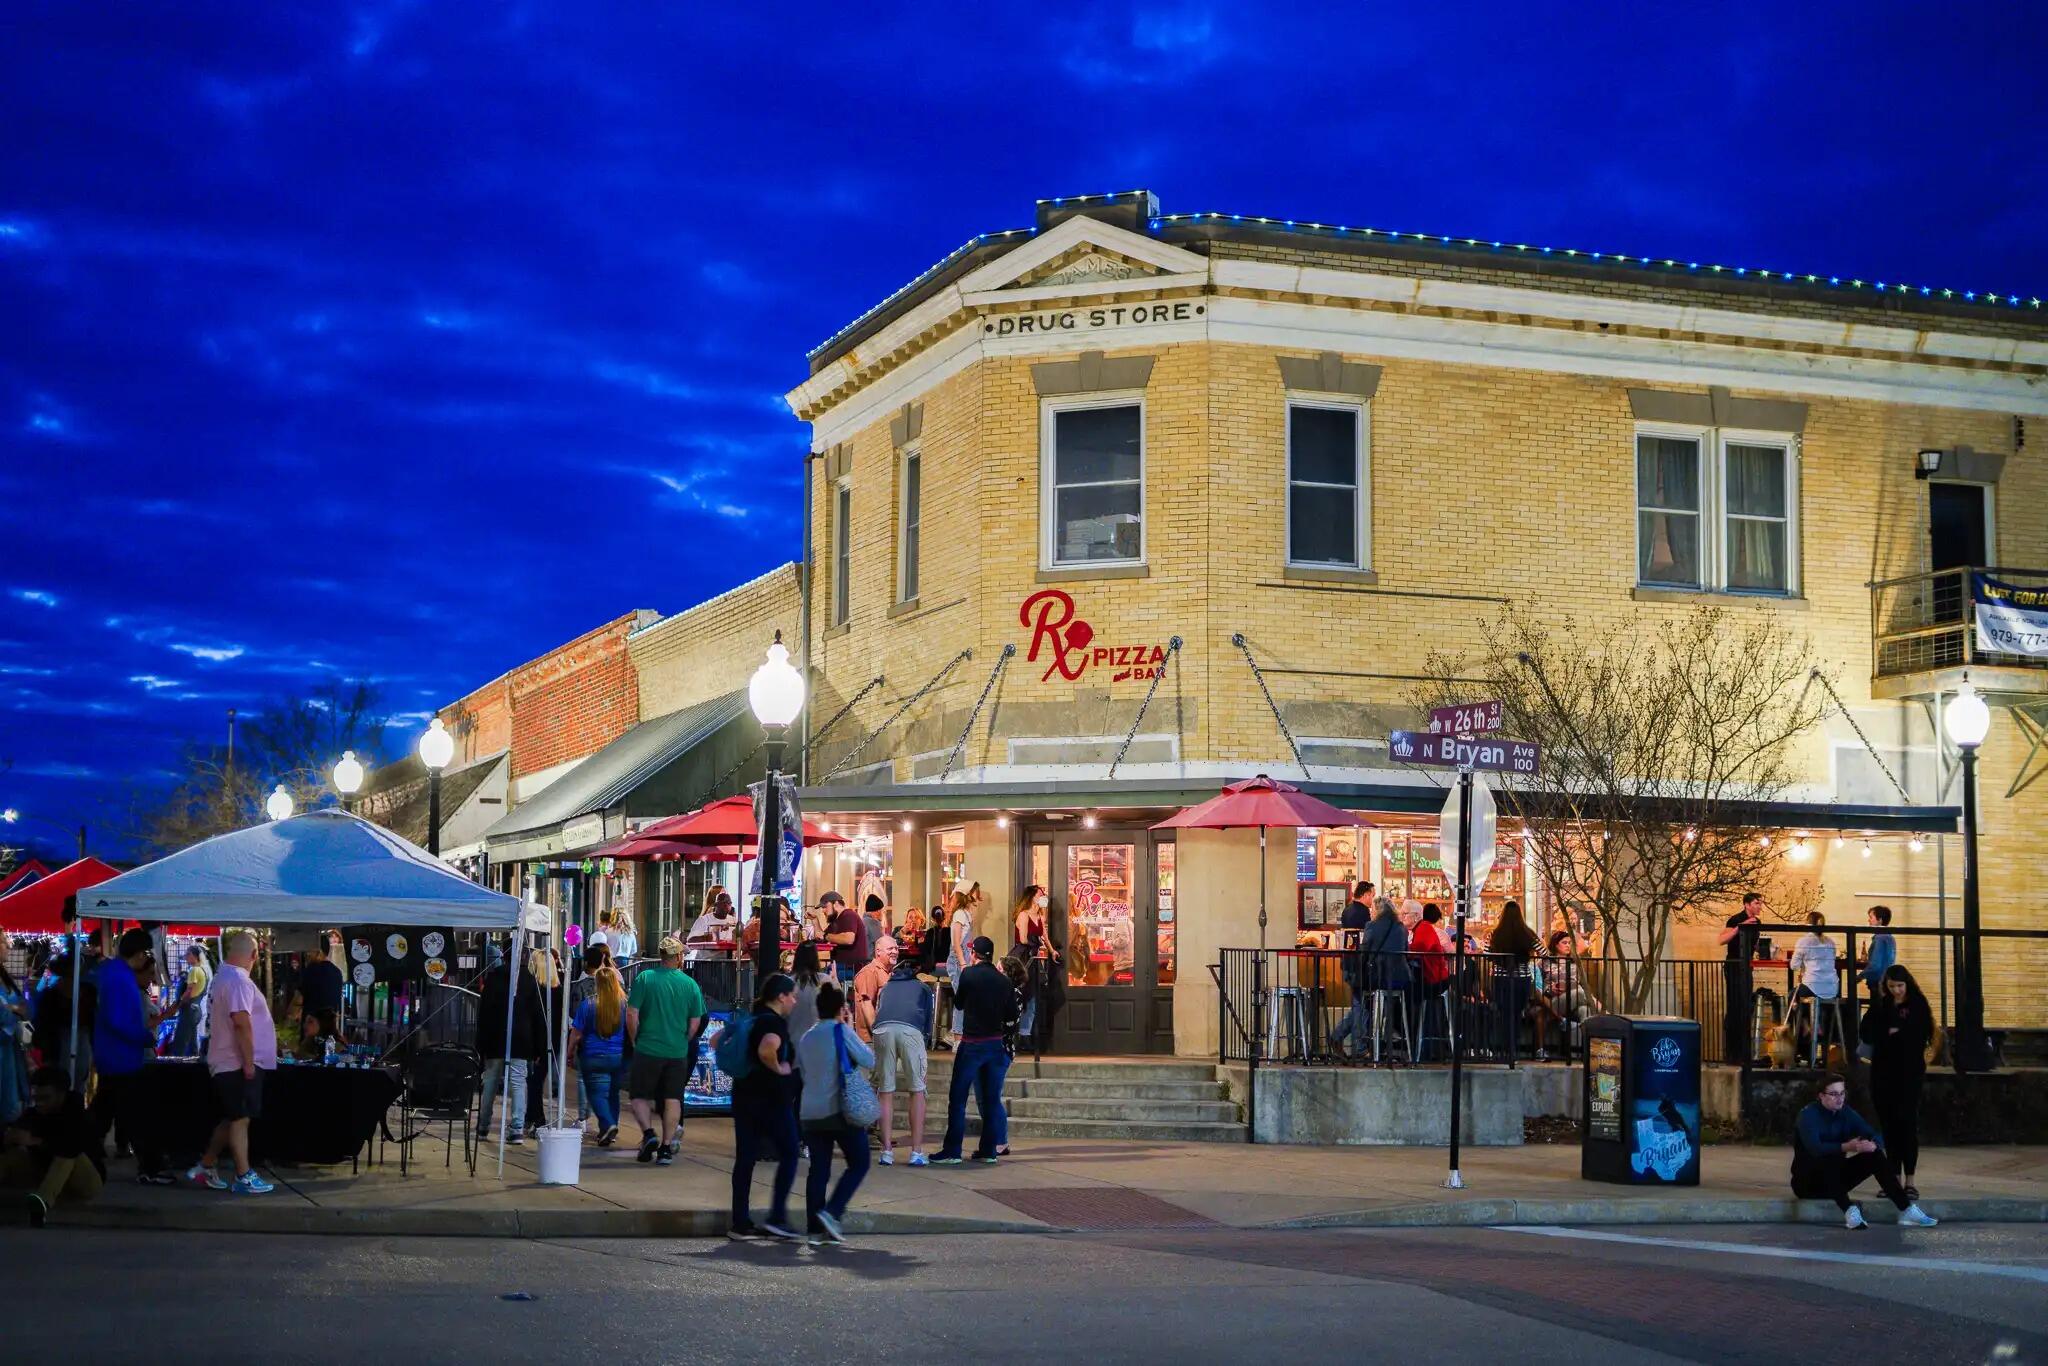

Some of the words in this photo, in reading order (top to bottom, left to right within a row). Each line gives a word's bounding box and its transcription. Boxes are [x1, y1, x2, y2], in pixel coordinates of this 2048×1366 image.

[999, 313, 1075, 335] DRUG
[1090, 303, 1190, 327] STORE
[1991, 628, 2048, 645] 979-777-
[1093, 645, 1164, 667] PIZZA
[1490, 703, 1498, 714] St
[1487, 717, 1500, 730] 200
[1423, 744, 1433, 758] N
[1441, 738, 1505, 766] Bryan
[1512, 744, 1535, 758] Ave
[1514, 758, 1533, 771] 100
[1650, 1047, 1681, 1063] Bryan
[1592, 1101, 1615, 1112] EXPLORE
[1640, 1138, 1688, 1168] Bryan
